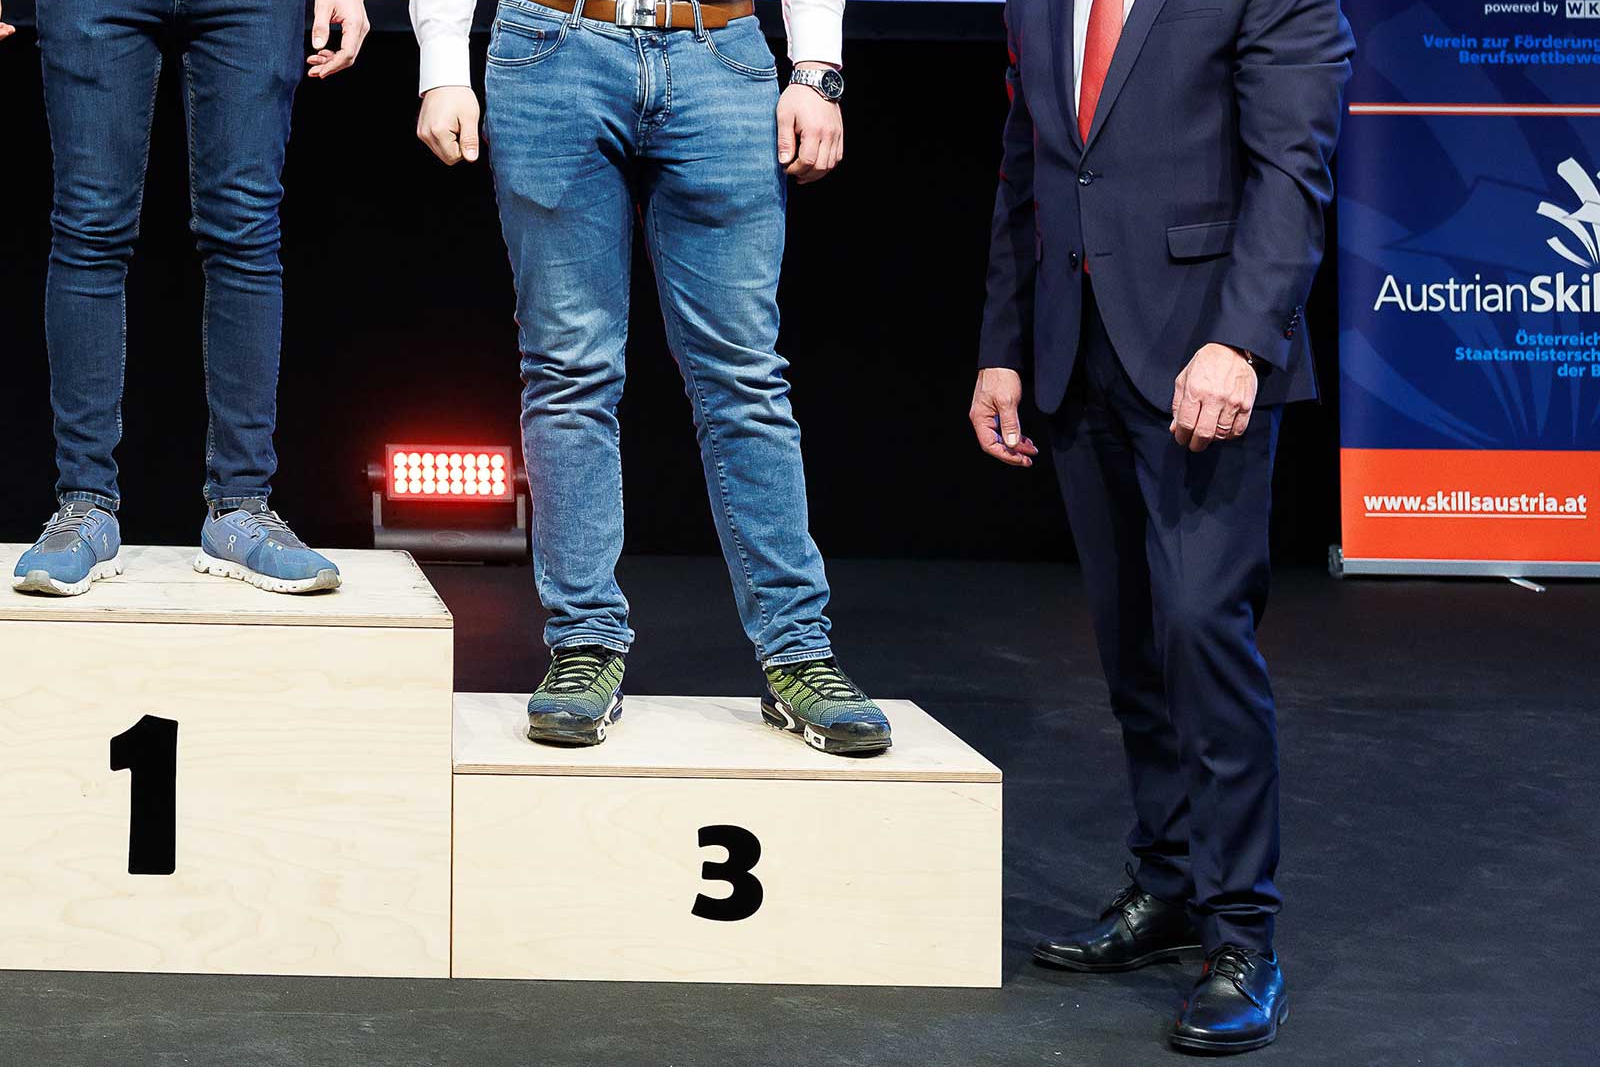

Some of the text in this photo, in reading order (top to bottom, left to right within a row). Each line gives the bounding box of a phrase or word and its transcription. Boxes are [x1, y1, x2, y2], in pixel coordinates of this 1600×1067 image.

[1484, 1, 1540, 15] powered
[1543, 1, 1558, 16] by
[1423, 35, 1478, 49] Verein
[1482, 37, 1510, 49] zur
[1557, 363, 1586, 377] der
[1364, 491, 1587, 513] www.skillsaustria.at
[110, 715, 178, 875] 1
[691, 825, 763, 921] 3
